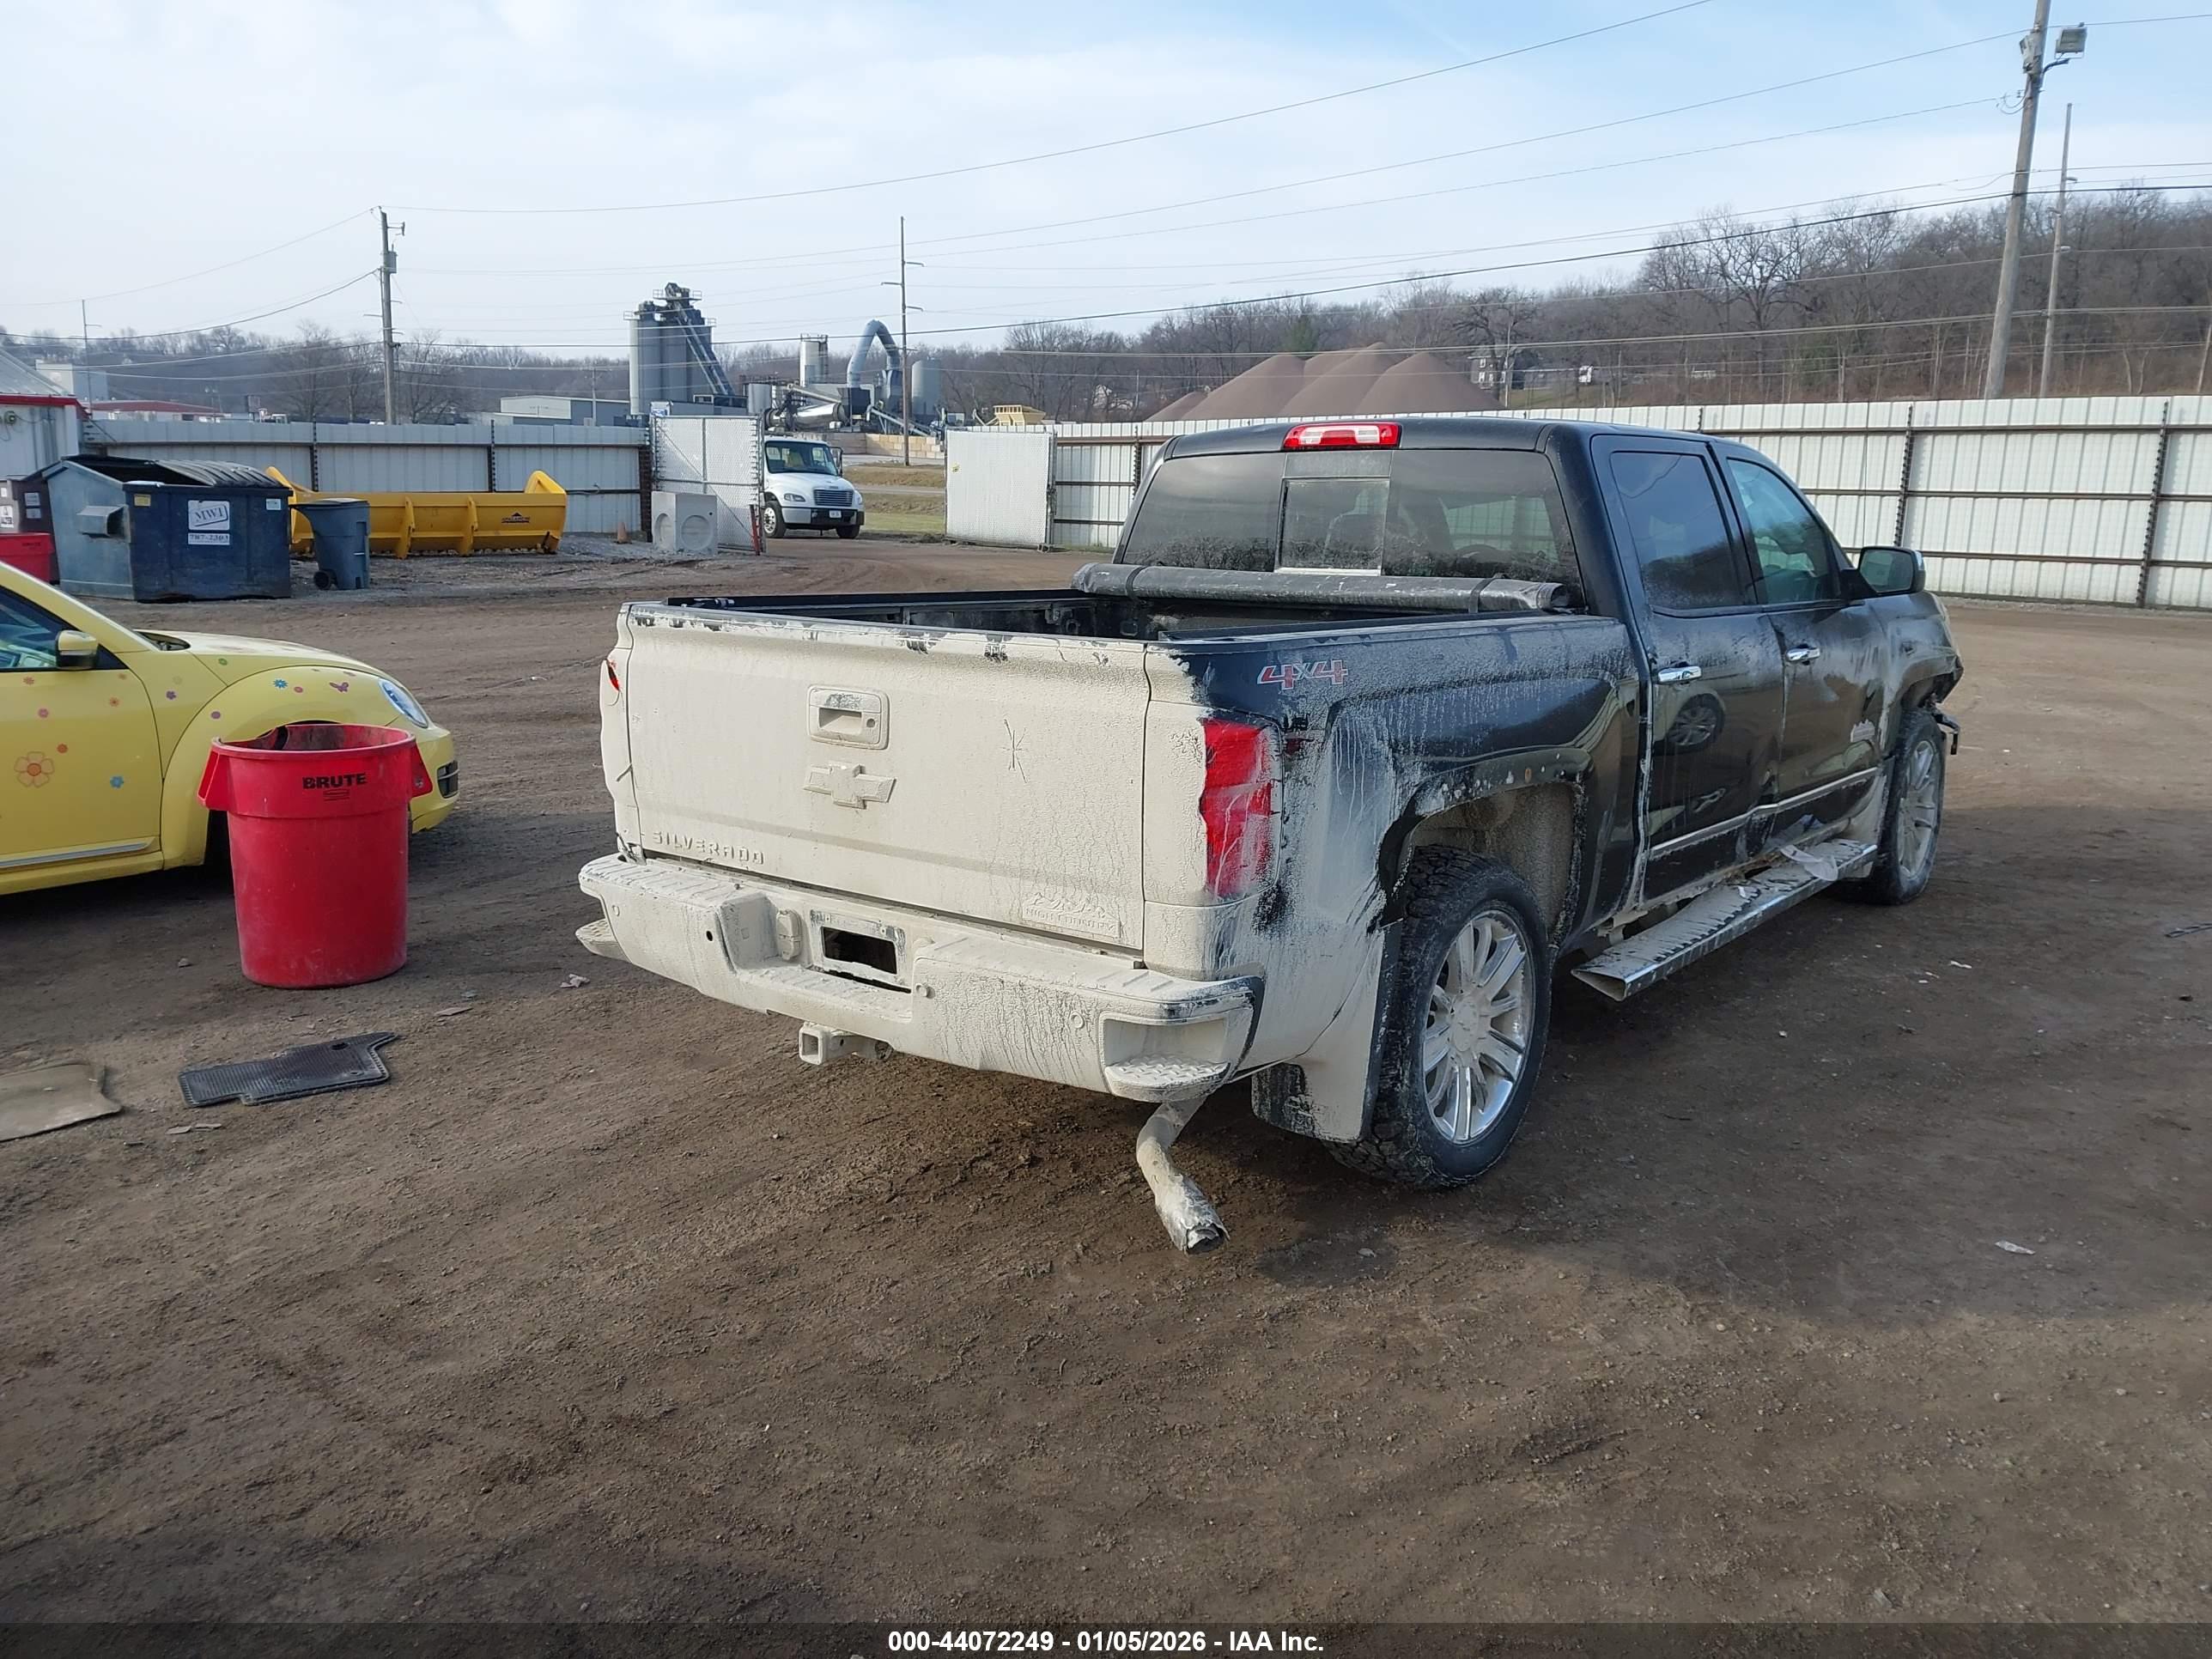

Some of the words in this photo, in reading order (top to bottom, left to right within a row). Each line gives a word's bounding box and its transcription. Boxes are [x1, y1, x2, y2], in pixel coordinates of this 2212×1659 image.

[194, 507, 224, 522] MWI
[302, 773, 368, 789] BRUTE
[652, 830, 764, 865] SILVERADO
